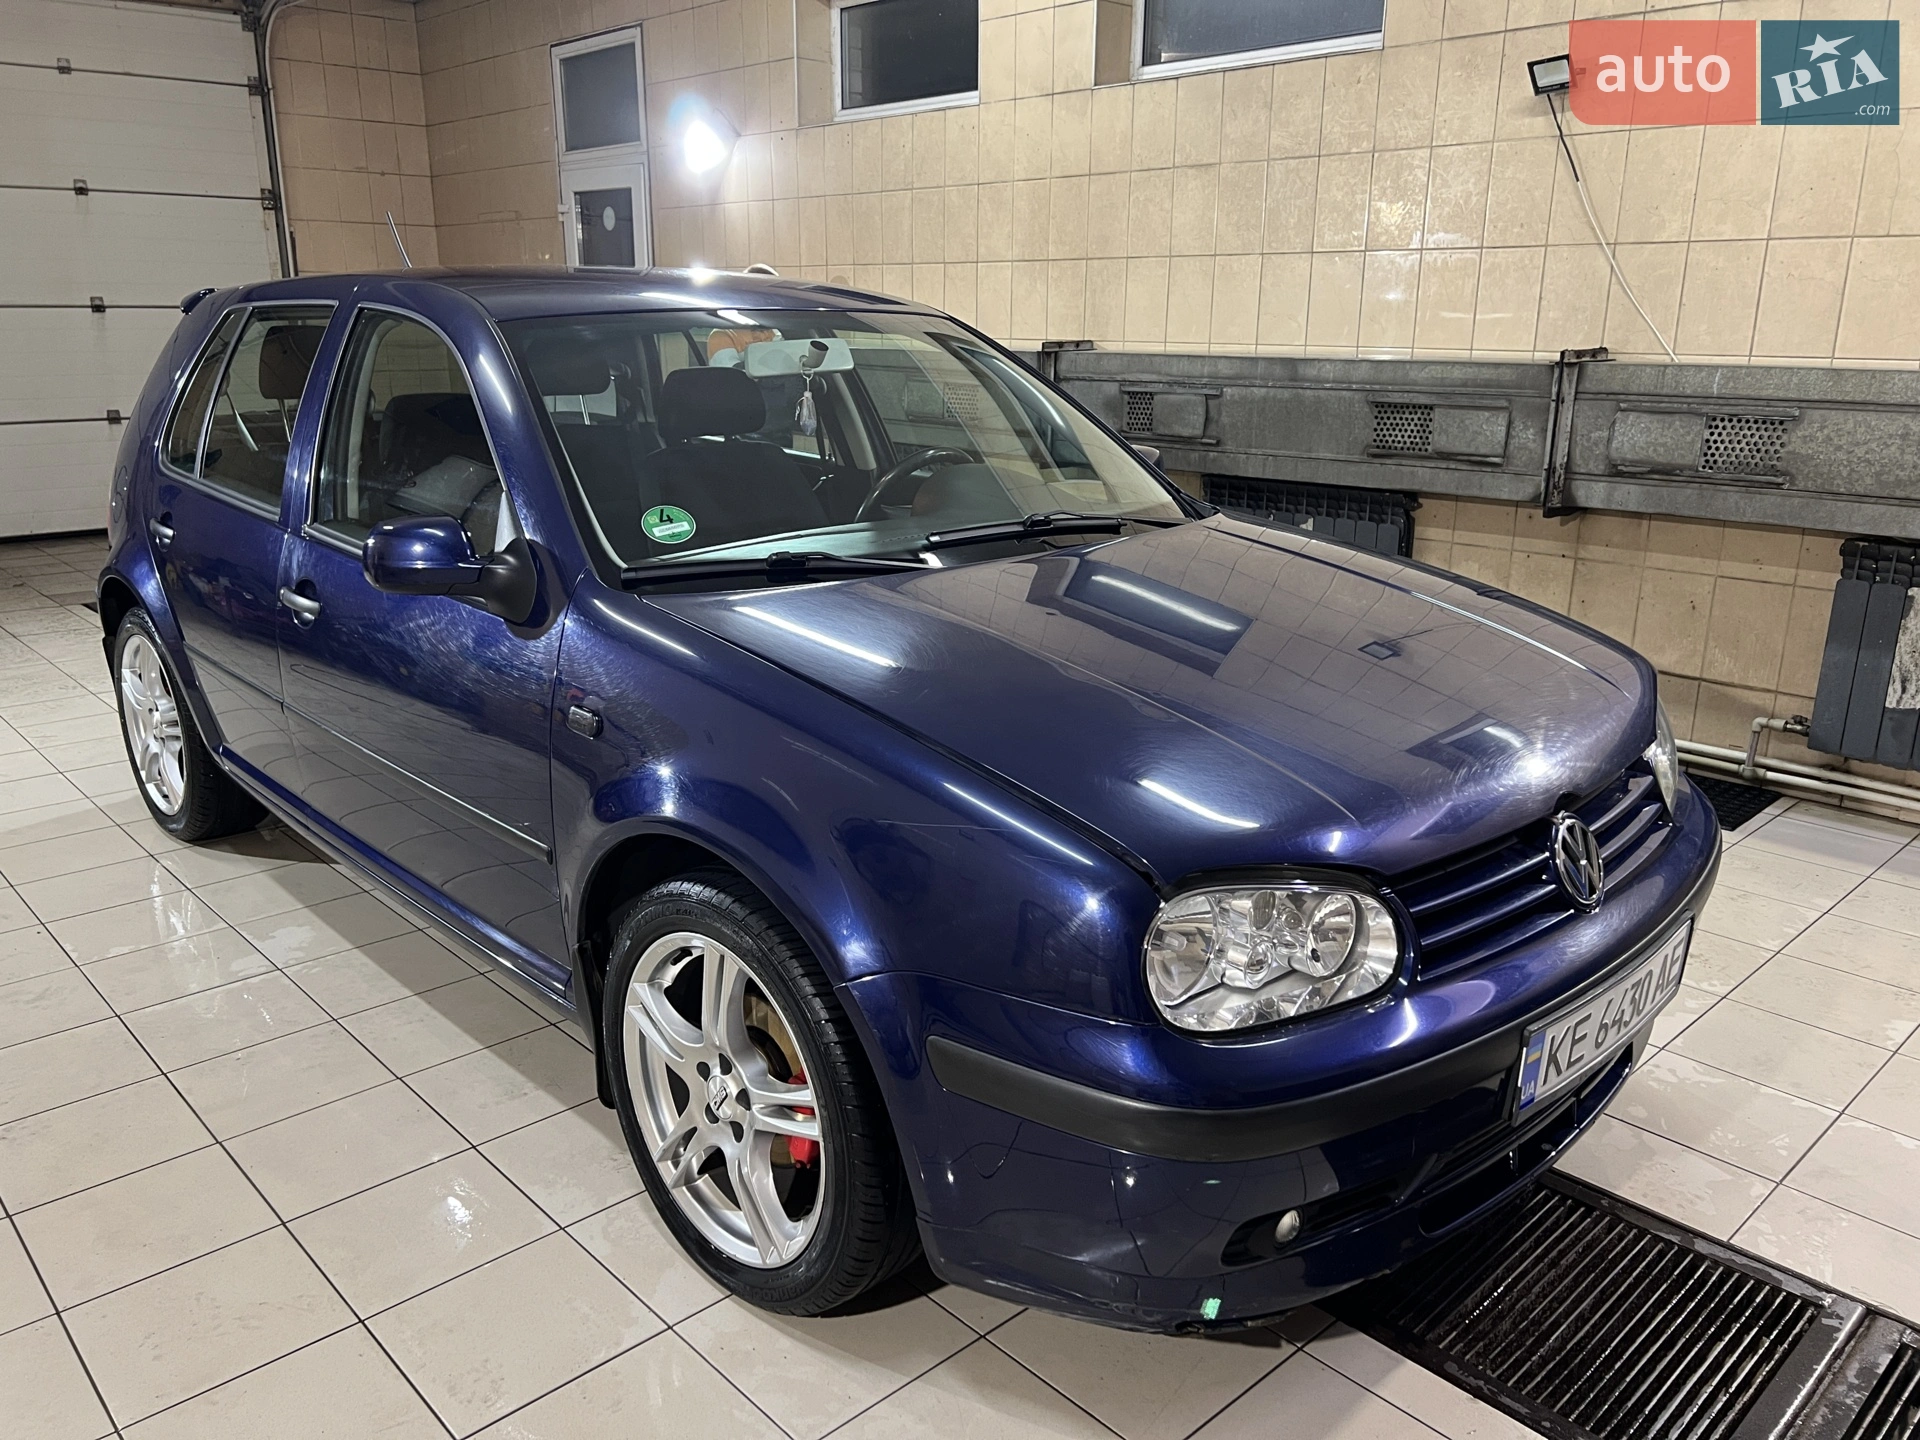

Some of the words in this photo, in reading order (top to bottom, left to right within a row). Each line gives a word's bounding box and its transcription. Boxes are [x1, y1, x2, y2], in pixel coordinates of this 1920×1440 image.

[660, 509, 673, 523] 4
[1540, 1012, 1592, 1087] KE
[1594, 968, 1653, 1050] 6430
[1653, 938, 1685, 1002] AE
[1521, 1080, 1535, 1100] UA
